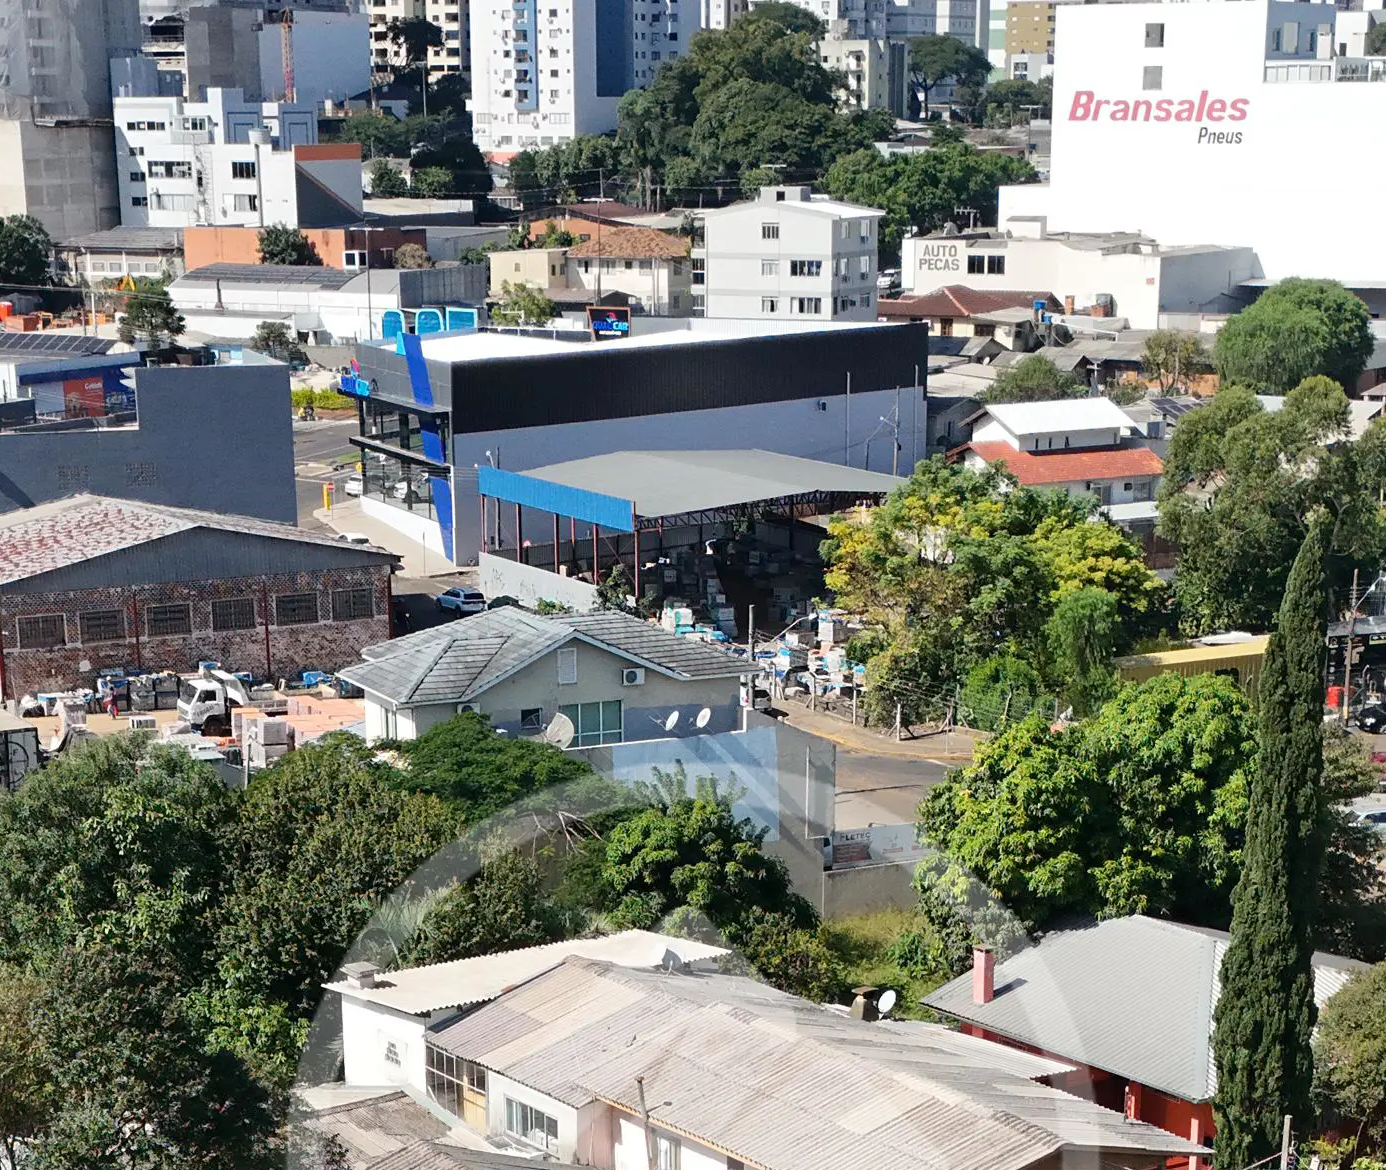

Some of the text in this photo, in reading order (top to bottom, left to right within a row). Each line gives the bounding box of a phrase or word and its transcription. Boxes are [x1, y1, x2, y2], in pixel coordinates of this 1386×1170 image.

[1068, 90, 1250, 122] Bransales
[1197, 126, 1243, 144] Pneus
[923, 244, 958, 257] AUTO
